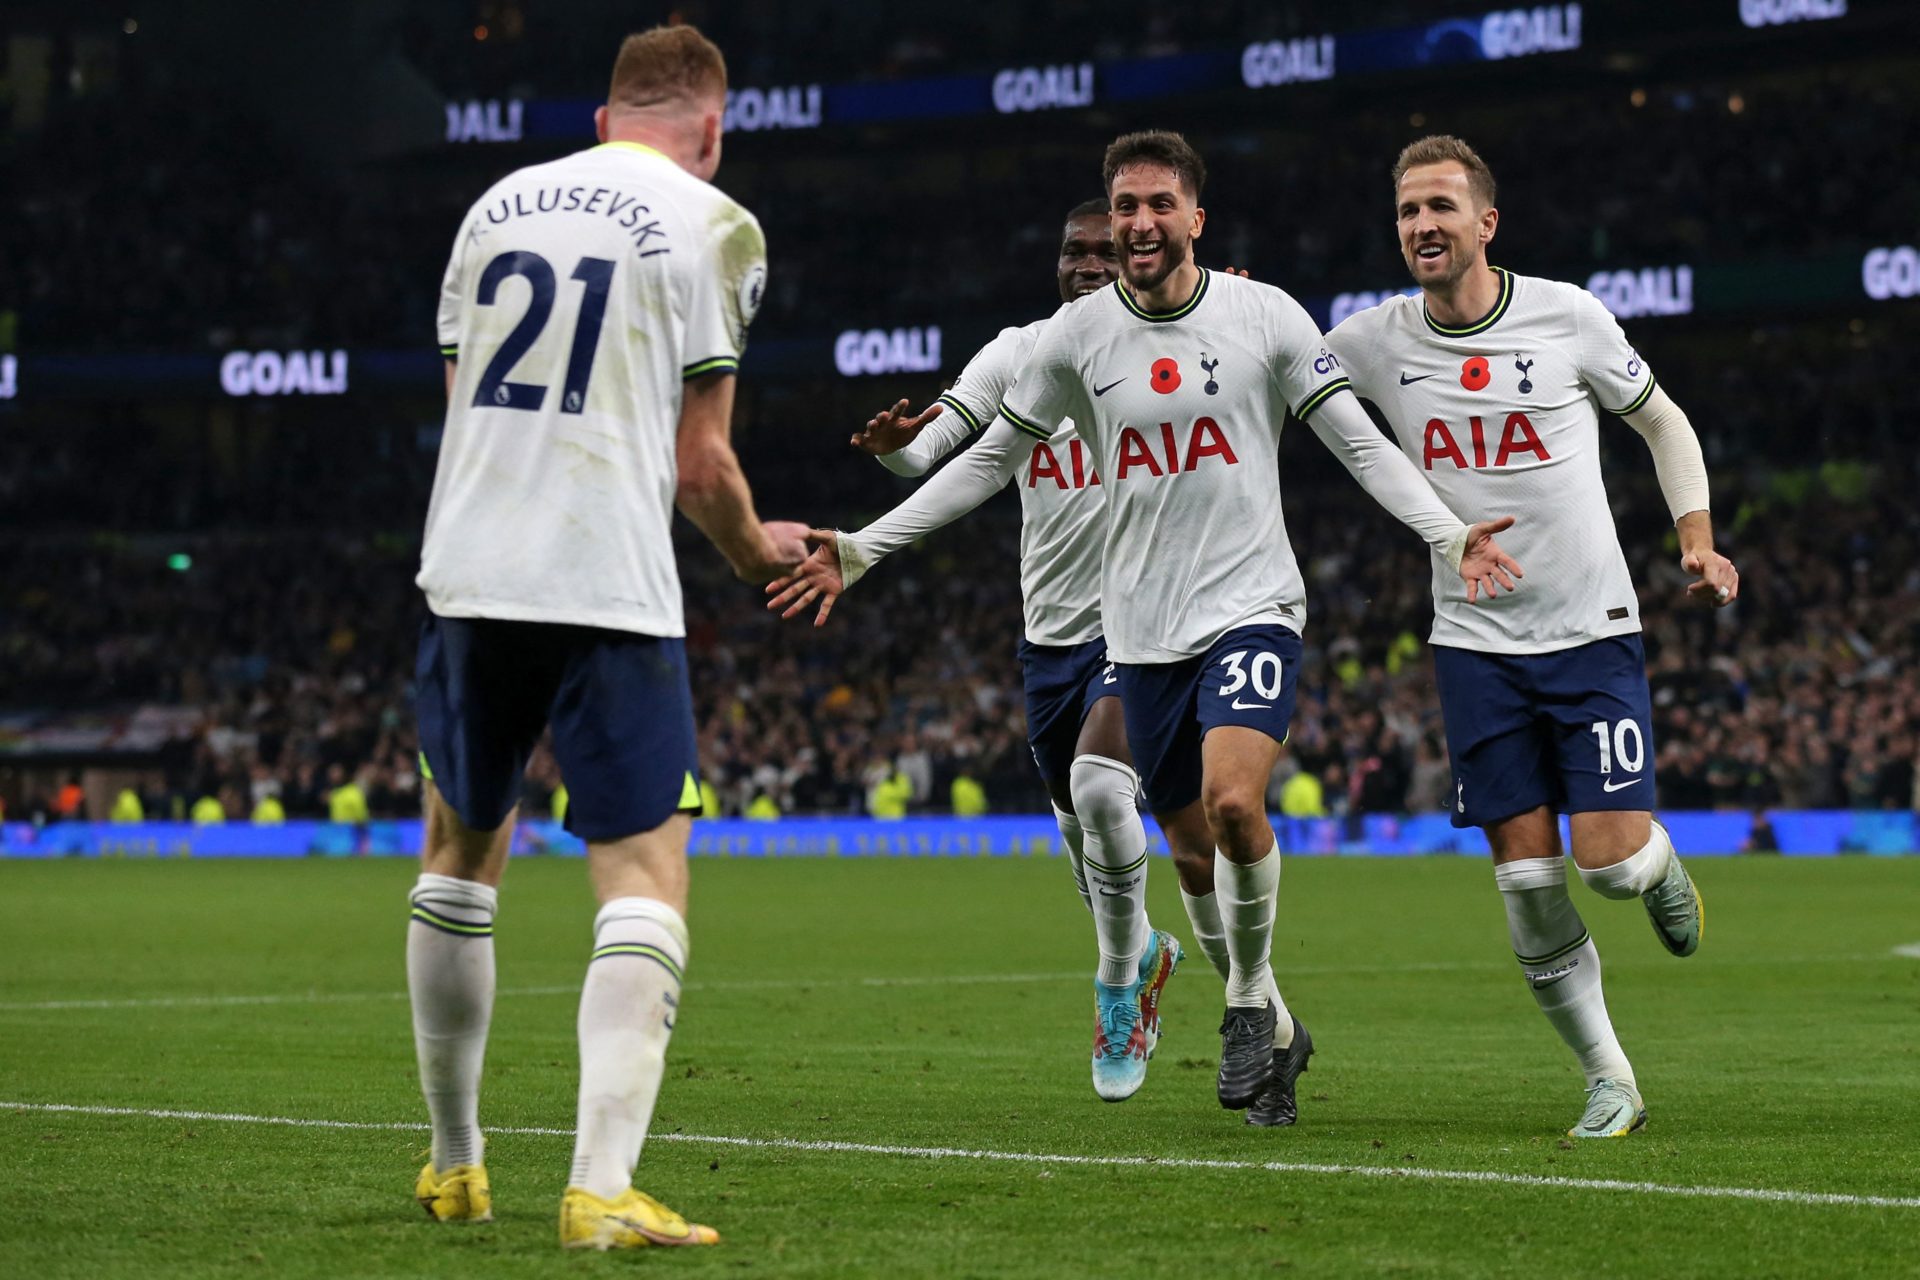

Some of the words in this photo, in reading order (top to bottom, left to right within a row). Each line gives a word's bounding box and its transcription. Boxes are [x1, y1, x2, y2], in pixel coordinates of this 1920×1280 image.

[1480, 4, 1582, 60] GOAL!
[993, 63, 1093, 113] GOAL!
[1242, 36, 1335, 88] GOAL!
[469, 187, 671, 258] KULUSEVSKI
[1586, 264, 1693, 319] GOAL!
[471, 250, 617, 415] 21
[834, 326, 942, 377] GOAL!
[220, 350, 348, 397] GOAL!
[1117, 416, 1239, 480] AIA
[1423, 412, 1551, 471] AIA
[1219, 651, 1283, 700] 30
[1592, 718, 1644, 774] 10
[1092, 875, 1141, 889] SPURS
[1524, 957, 1580, 981] SPURS
